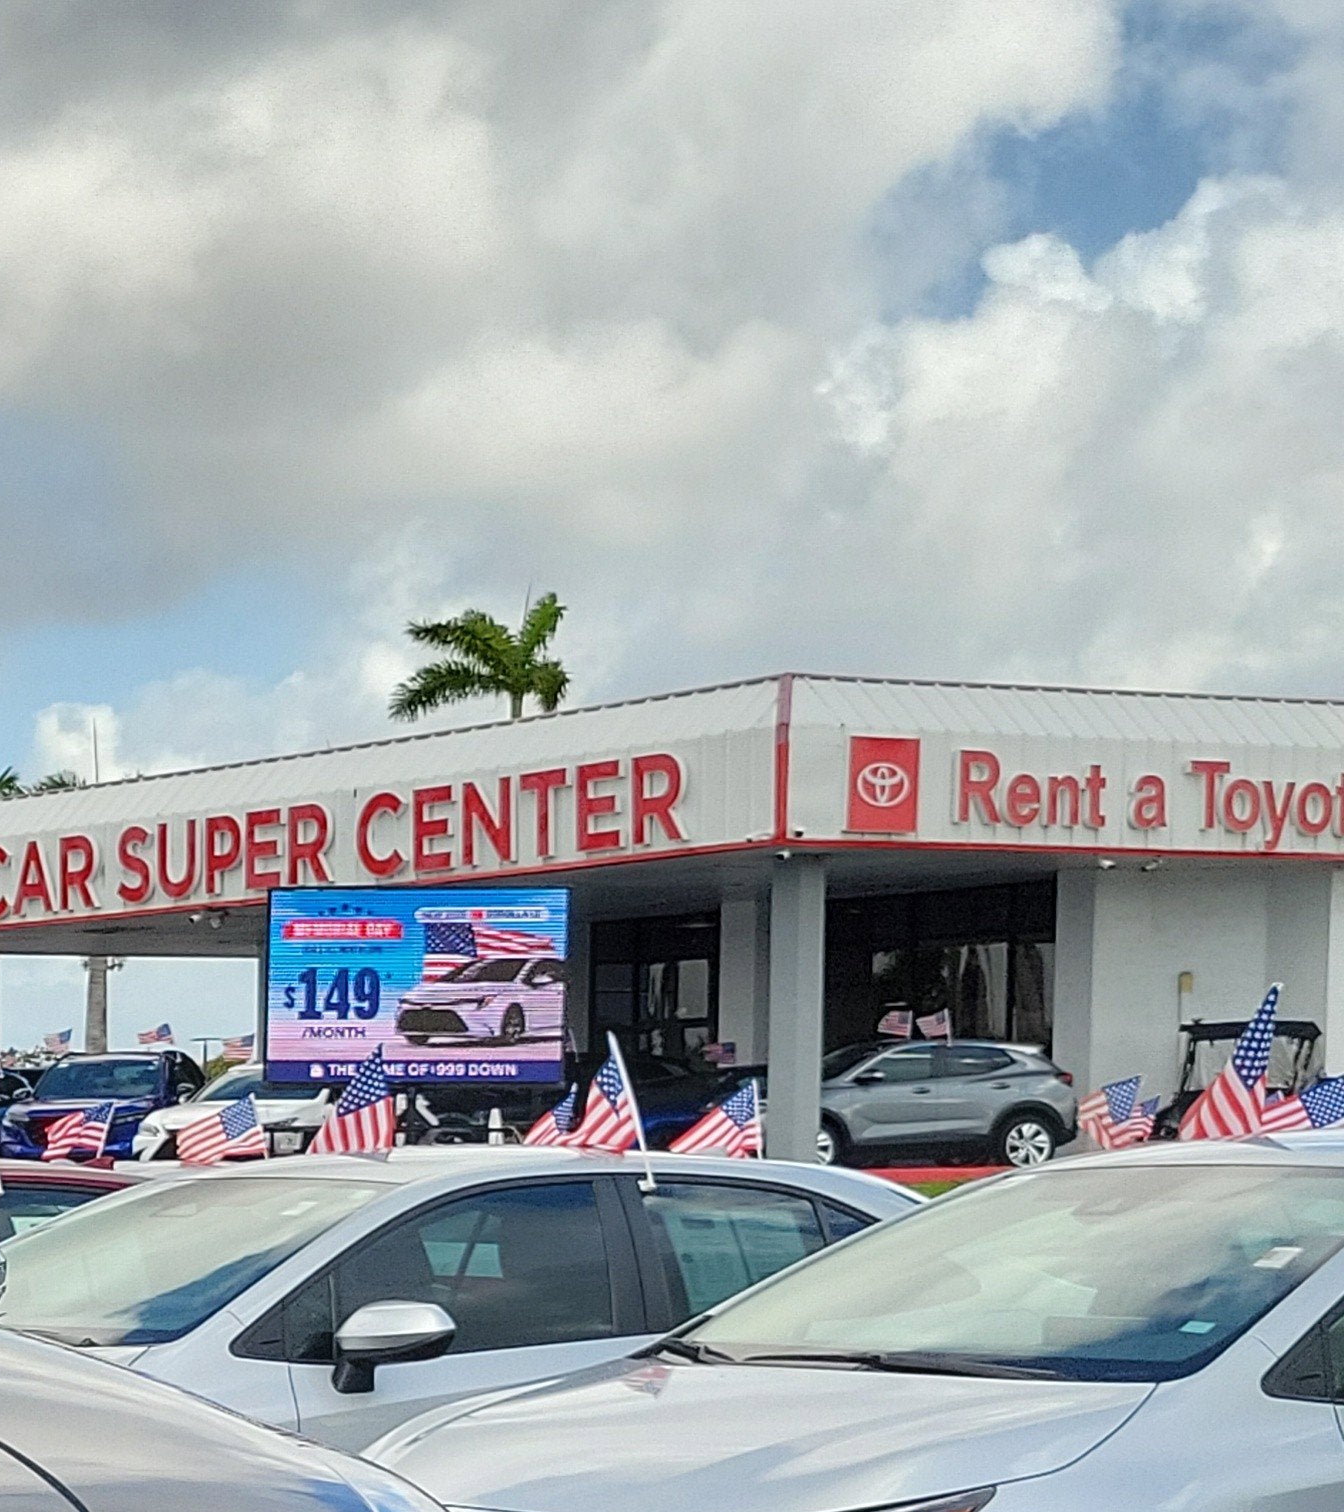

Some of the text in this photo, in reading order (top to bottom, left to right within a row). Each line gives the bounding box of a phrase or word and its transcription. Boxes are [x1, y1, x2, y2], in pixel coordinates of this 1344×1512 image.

[957, 749, 1107, 829] Rent
[1132, 774, 1167, 829] a
[116, 803, 334, 903] SUPER
[356, 754, 688, 880] CENTER
[301, 1026, 367, 1039] /MONTH
[327, 1064, 357, 1077] THE
[408, 1064, 429, 1077] OF
[468, 1064, 517, 1077] DOWN
